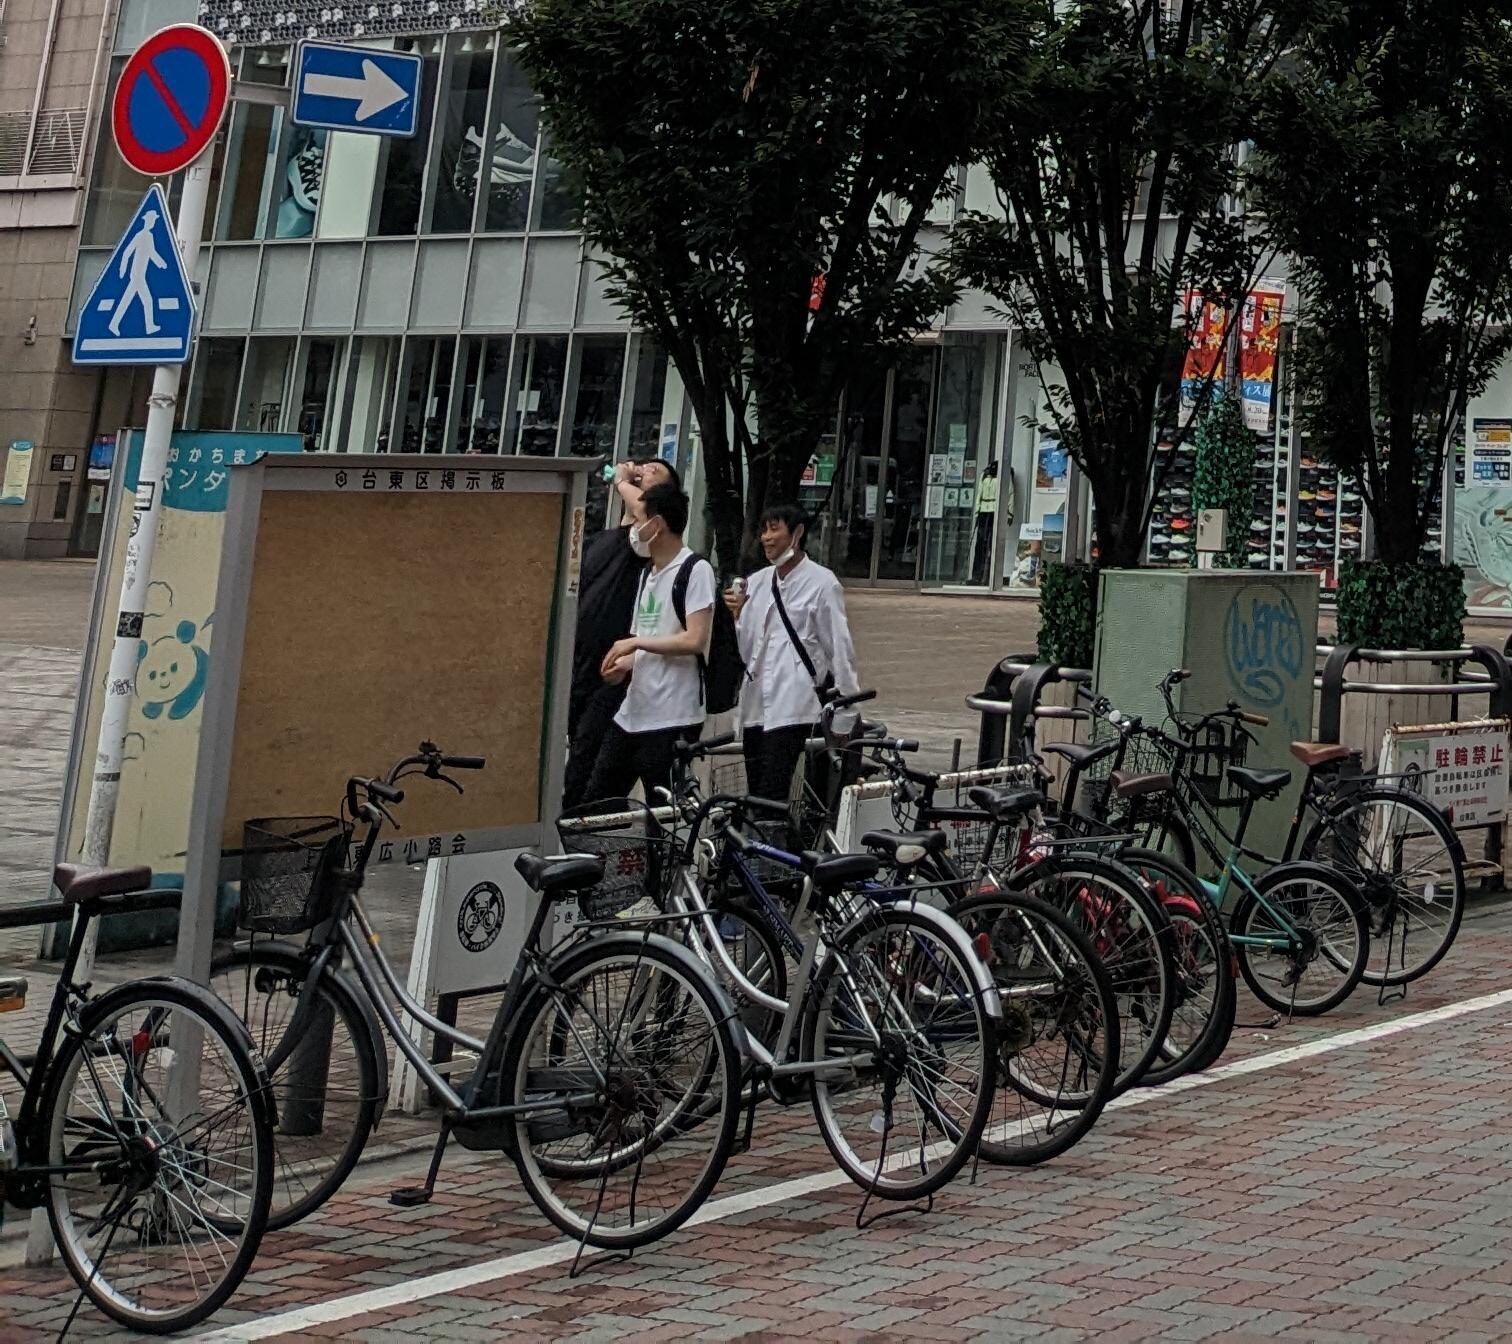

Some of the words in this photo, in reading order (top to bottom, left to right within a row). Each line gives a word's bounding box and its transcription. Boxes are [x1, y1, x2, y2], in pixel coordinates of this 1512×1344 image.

[362, 469, 505, 490] 台東区掲示板
[1435, 744, 1504, 768] 駐輪禁止
